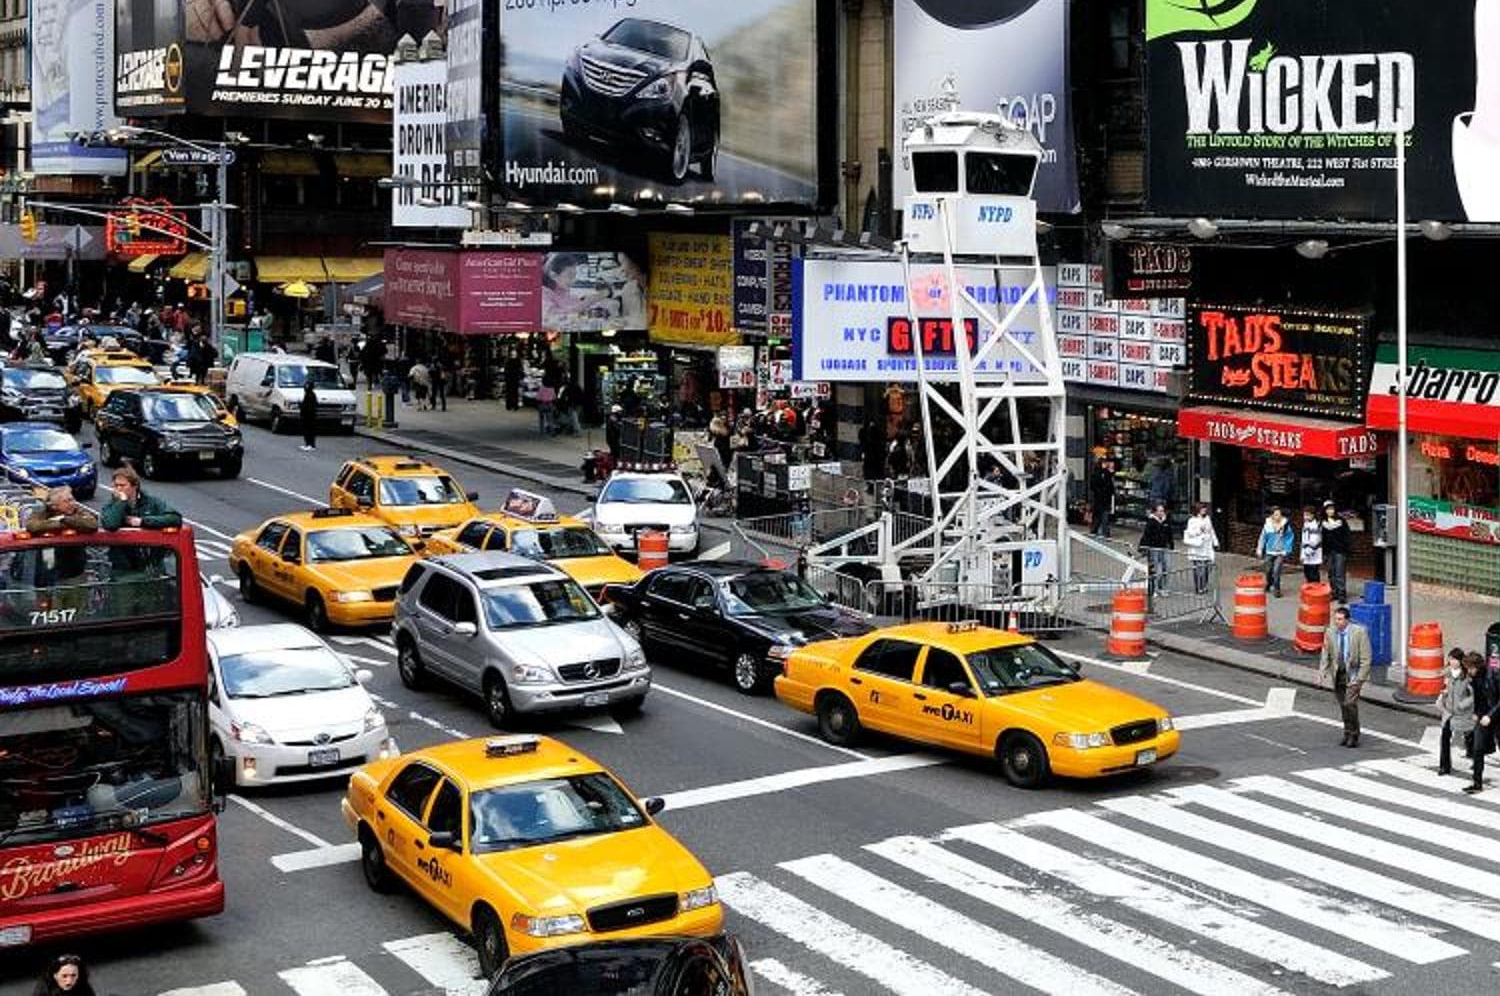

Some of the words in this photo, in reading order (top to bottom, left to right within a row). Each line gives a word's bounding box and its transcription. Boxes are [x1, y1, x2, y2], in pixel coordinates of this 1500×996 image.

[214, 45, 395, 94] LEVERAG
[212, 90, 280, 104] PREMIERES
[282, 93, 329, 107] SUNDAY
[332, 95, 364, 108] JUNE
[365, 97, 380, 109] 20
[168, 151, 186, 162] Van
[505, 160, 598, 188] Hyundai.com
[978, 206, 1012, 222] NYPD
[1061, 267, 1081, 283] CAPS
[823, 283, 905, 302] PHANTOM
[843, 327, 881, 342] NYC
[891, 320, 974, 352] GFTS
[1061, 315, 1081, 330] CAPS
[1125, 319, 1145, 335] CAPS
[1201, 311, 1281, 361] TAD'S
[1093, 341, 1113, 356] CAPS
[1159, 347, 1180, 362] CAPS
[1061, 362, 1081, 377] CAPS
[1125, 370, 1145, 385] CAPS
[1252, 353, 1351, 398] STEAKS
[1390, 360, 1500, 405] sbarro
[1207, 421, 1236, 438] TAD'S
[1257, 425, 1302, 449] STEAKS
[1339, 433, 1377, 454] TAD'S
[30, 608, 77, 626] 71517
[2, 830, 132, 902] Broadway
